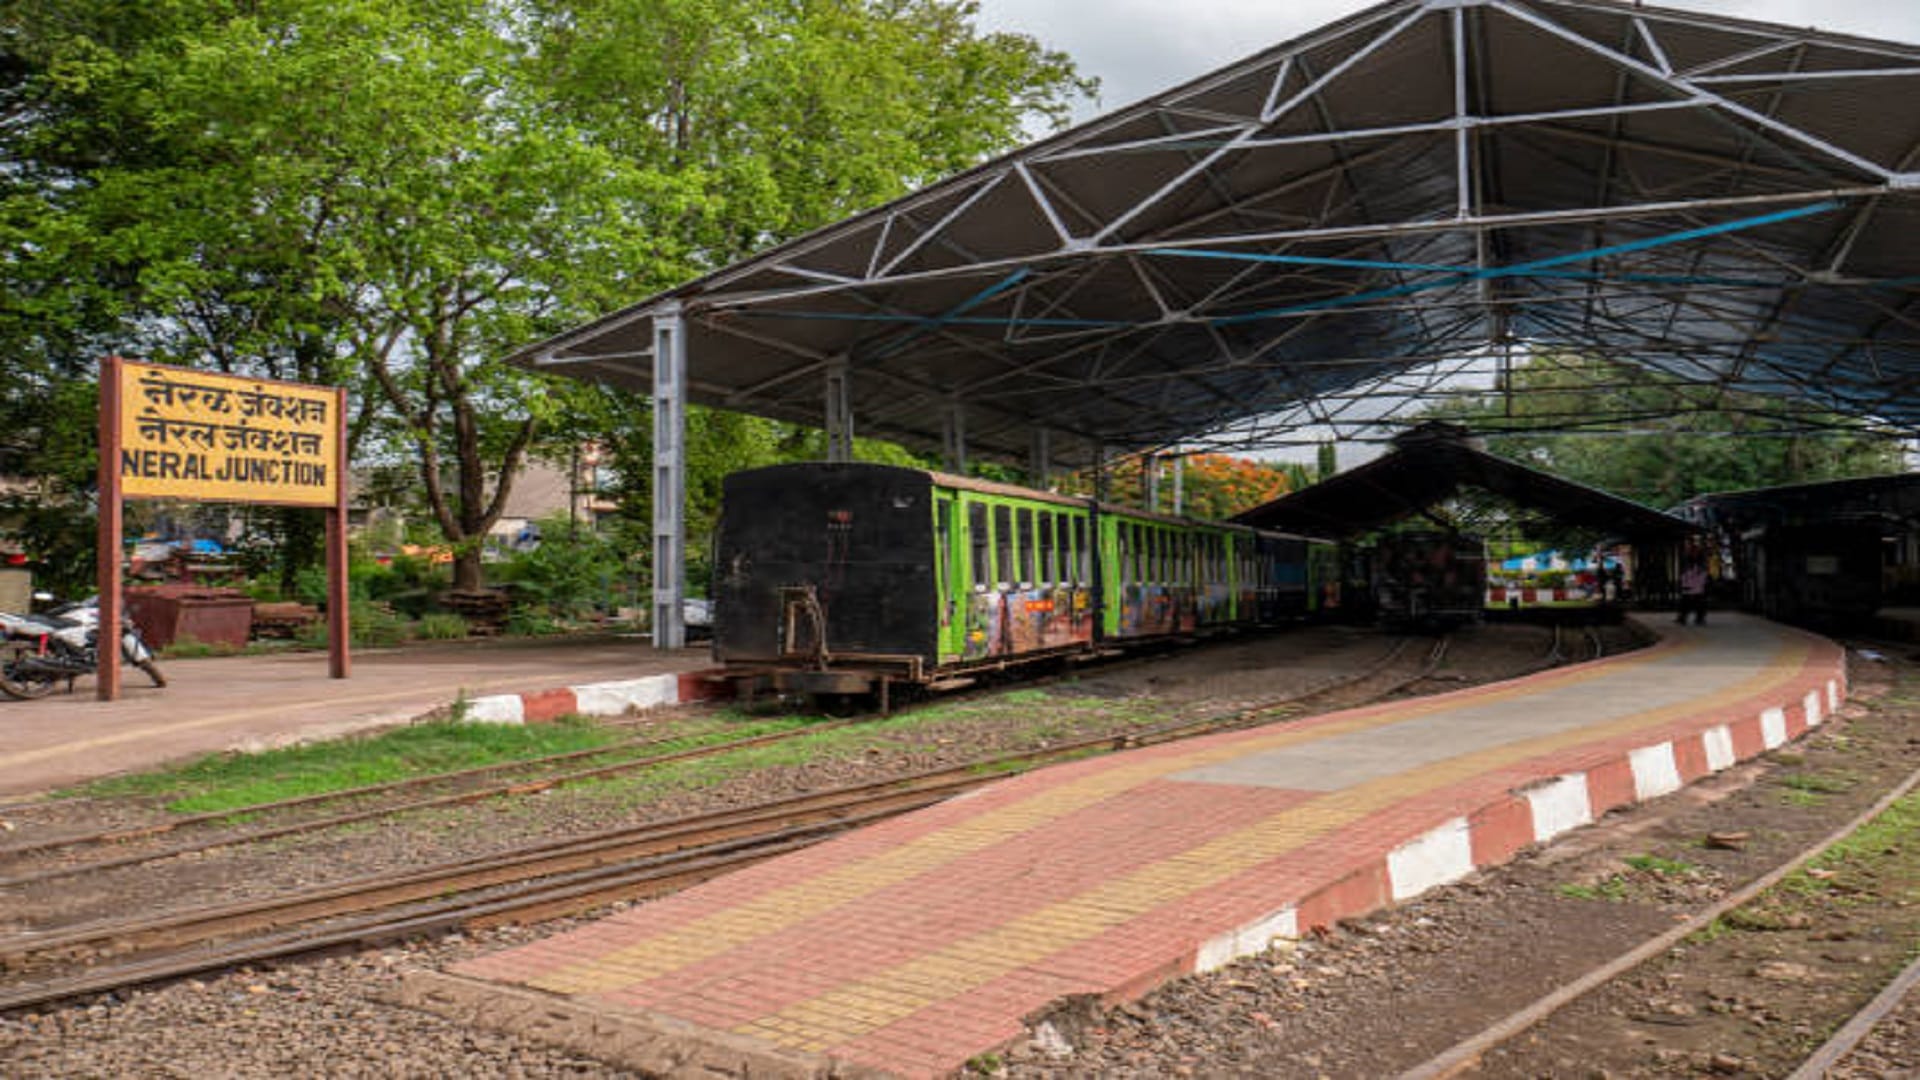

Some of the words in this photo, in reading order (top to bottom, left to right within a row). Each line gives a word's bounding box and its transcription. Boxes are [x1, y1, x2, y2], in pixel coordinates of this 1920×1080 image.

[139, 371, 232, 413] नेरळ
[136, 407, 220, 450] नेरल
[121, 449, 213, 480] NERAL
[215, 457, 326, 486] JUNCTION
